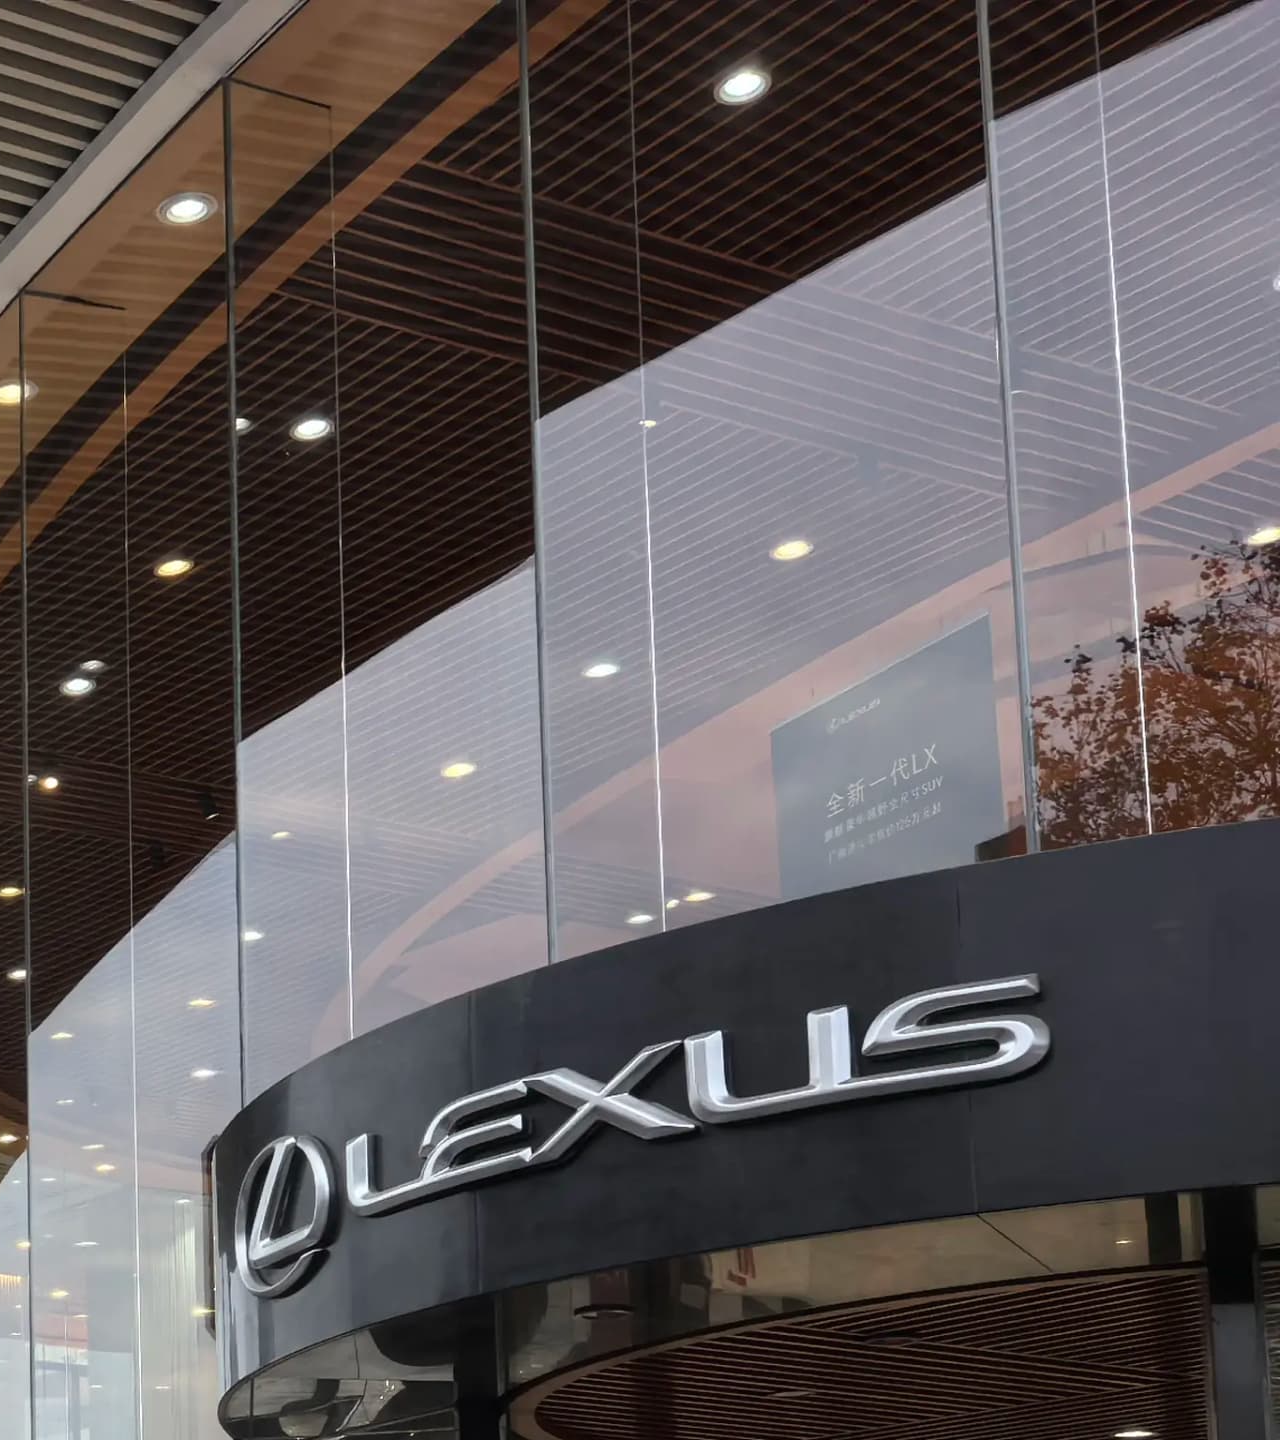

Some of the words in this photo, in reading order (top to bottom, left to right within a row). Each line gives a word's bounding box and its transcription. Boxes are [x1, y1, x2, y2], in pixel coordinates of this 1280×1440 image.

[826, 743, 938, 818] 全新一代LX
[346, 973, 1052, 1218] LEXUS
